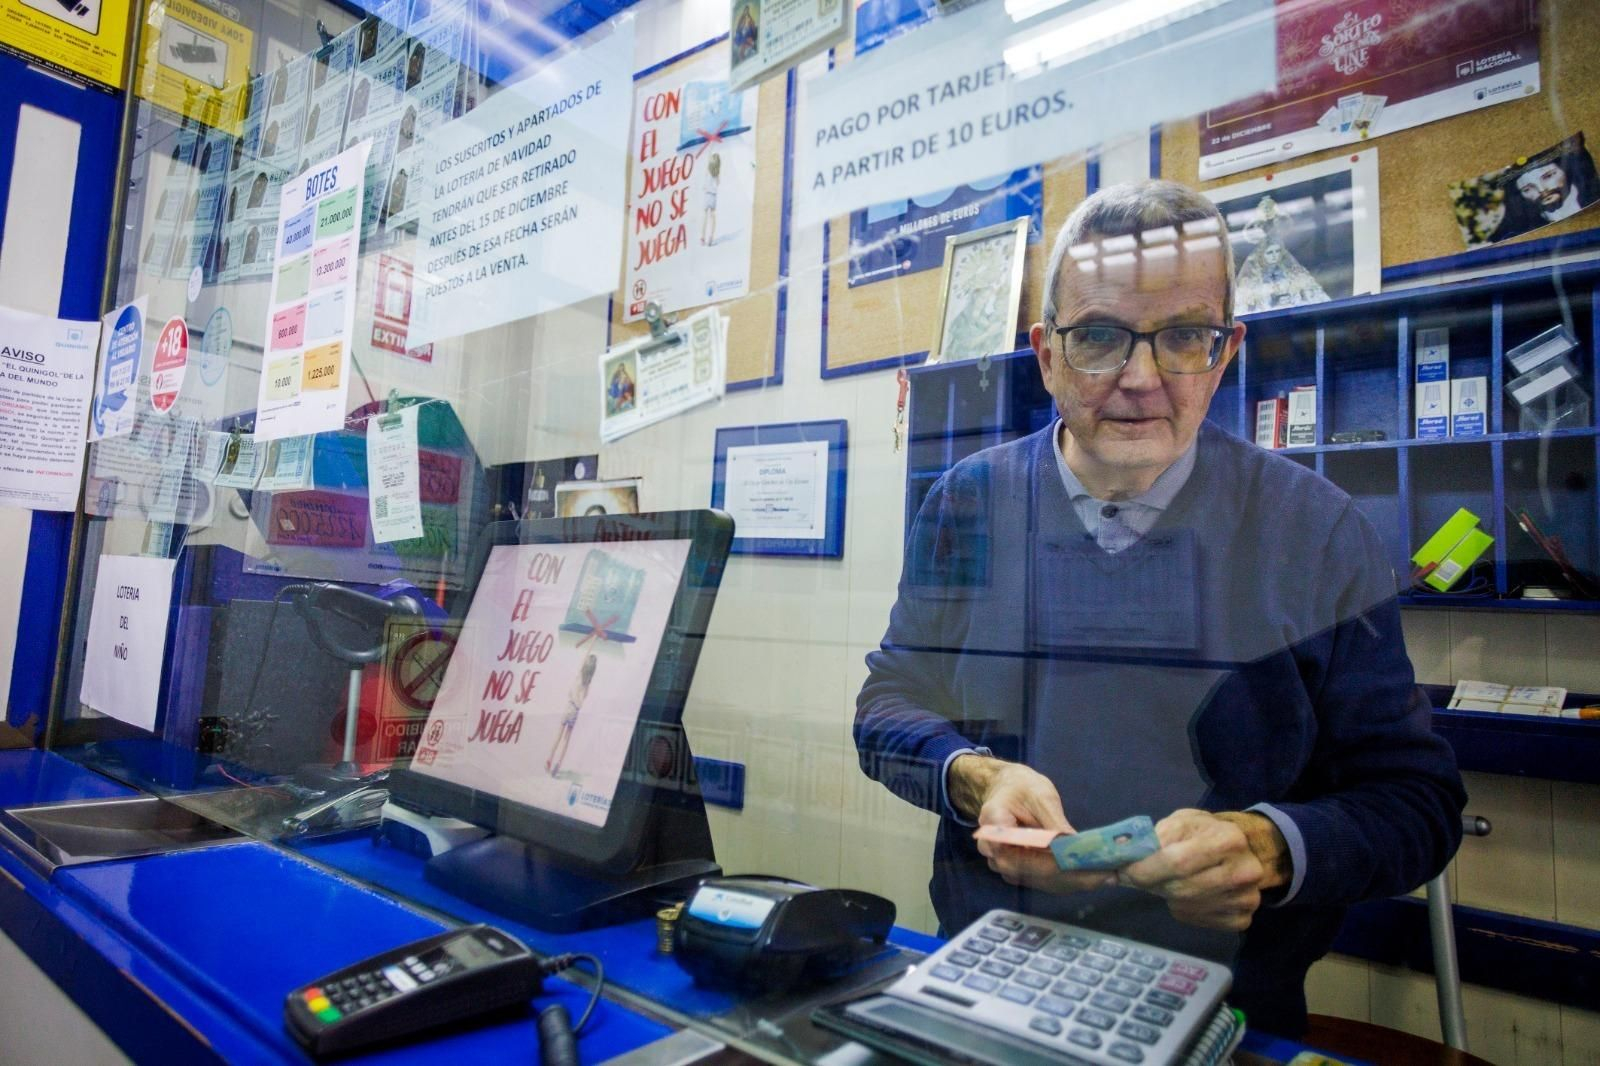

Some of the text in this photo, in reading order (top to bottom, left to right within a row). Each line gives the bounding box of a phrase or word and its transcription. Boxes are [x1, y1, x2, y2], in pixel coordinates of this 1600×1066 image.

[1319, 13, 1382, 56] SORTEO
[1476, 54, 1521, 72] NACIONAL
[644, 88, 681, 123] CON
[815, 61, 1015, 148] PAGO POR TARJET
[435, 80, 602, 175] LOS SUSCRITOS Y APARTADOS DE
[812, 89, 1074, 190] A PARTIR DE 10 EUROS.
[1231, 122, 1273, 140] DICIEMBRE
[640, 129, 658, 163] EL
[305, 165, 338, 201] BOTES
[434, 134, 552, 200] LA LOTERIA DE NAVIDAD
[638, 152, 694, 198] JUEGO
[432, 148, 577, 224] TENDRÁN QUE SER RETIRADO
[429, 180, 569, 249] ANTES DEL 15 DE DICIEMBRE
[635, 186, 690, 236] NO SE
[899, 216, 938, 234] MILLONES
[940, 211, 951, 223] DE
[952, 203, 980, 220] EUROS
[427, 205, 578, 274] DESPUÉS DE ESA FECHA SERÁN
[634, 223, 687, 271] JUEGA
[425, 253, 529, 300] PUESTOS A LA VENTA.
[1, 346, 45, 363] AVISO
[161, 325, 183, 358] +18
[8, 373, 25, 382] DEL
[26, 376, 58, 387] MUNDO
[527, 552, 566, 584] CON
[117, 585, 140, 601] LOTERIA
[510, 589, 531, 622] EL
[119, 615, 128, 630] DEL
[113, 642, 128, 661] NIÑO
[497, 629, 553, 664] JUEGO
[482, 670, 541, 704] NO SE
[468, 709, 524, 744] JUEGA
